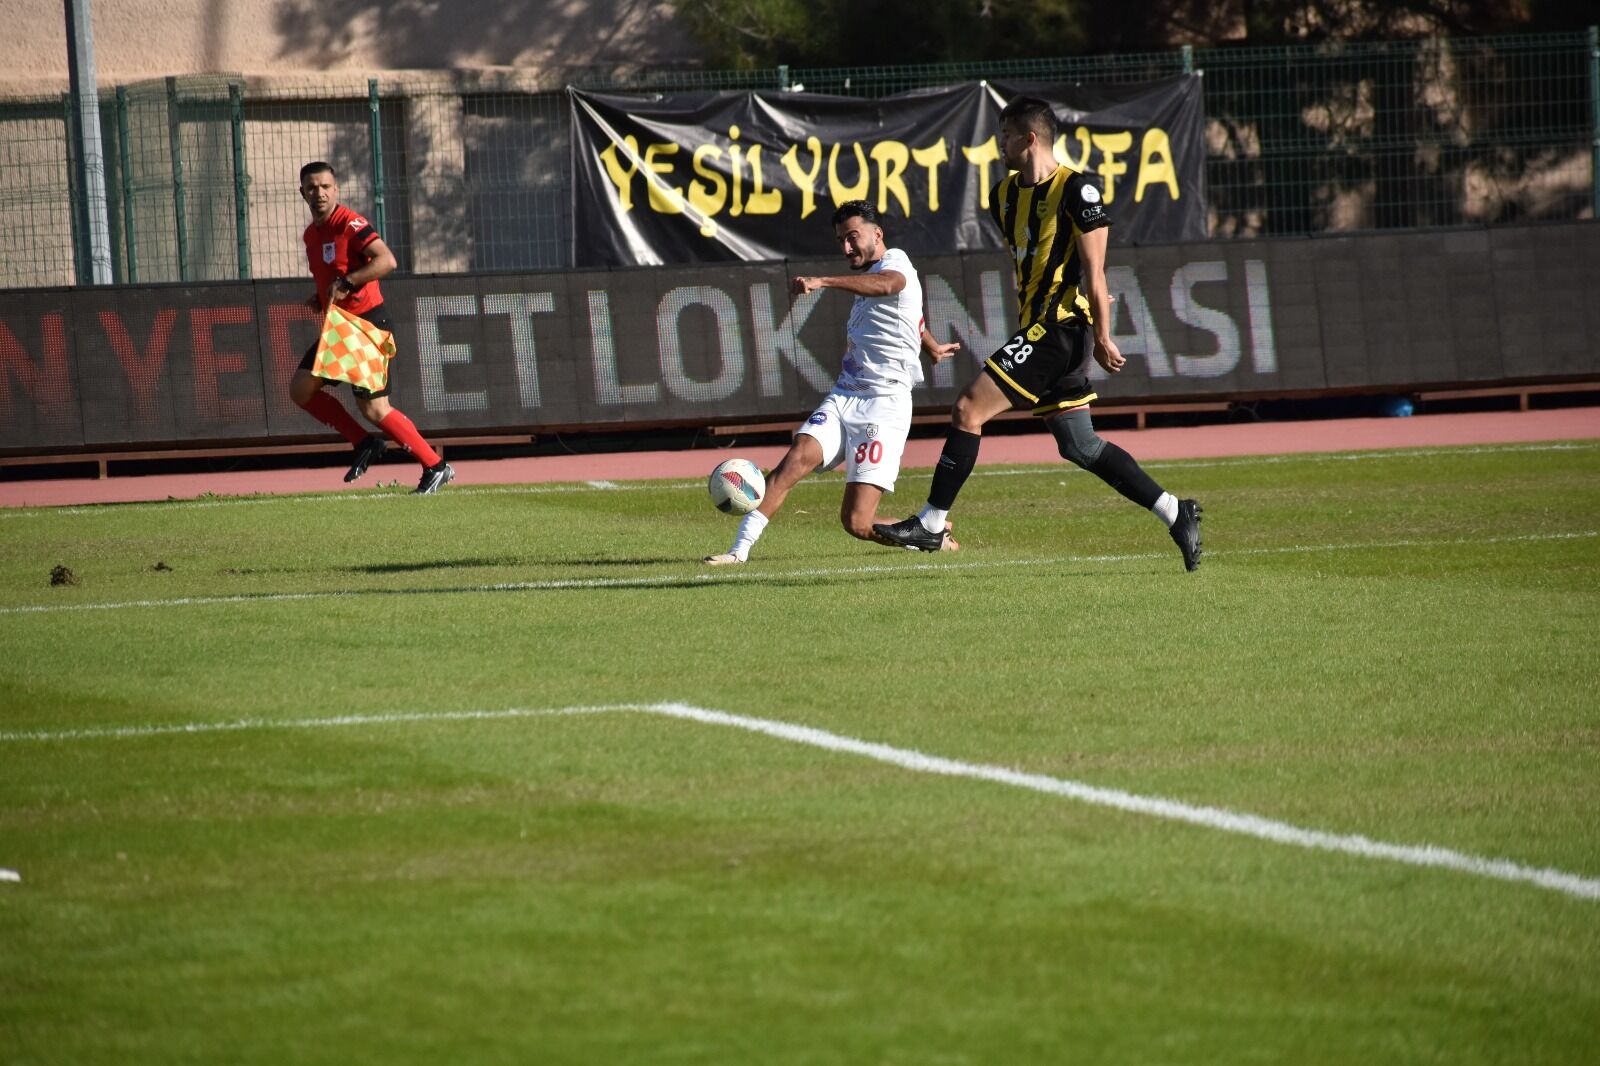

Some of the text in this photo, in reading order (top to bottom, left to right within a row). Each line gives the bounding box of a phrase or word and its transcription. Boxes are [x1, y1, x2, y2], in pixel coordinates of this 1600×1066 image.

[961, 126, 1180, 211] TYFA
[416, 292, 555, 413] ET
[587, 259, 1277, 405] LOKNASI
[1002, 335, 1033, 364] 28
[855, 440, 883, 464] 80
